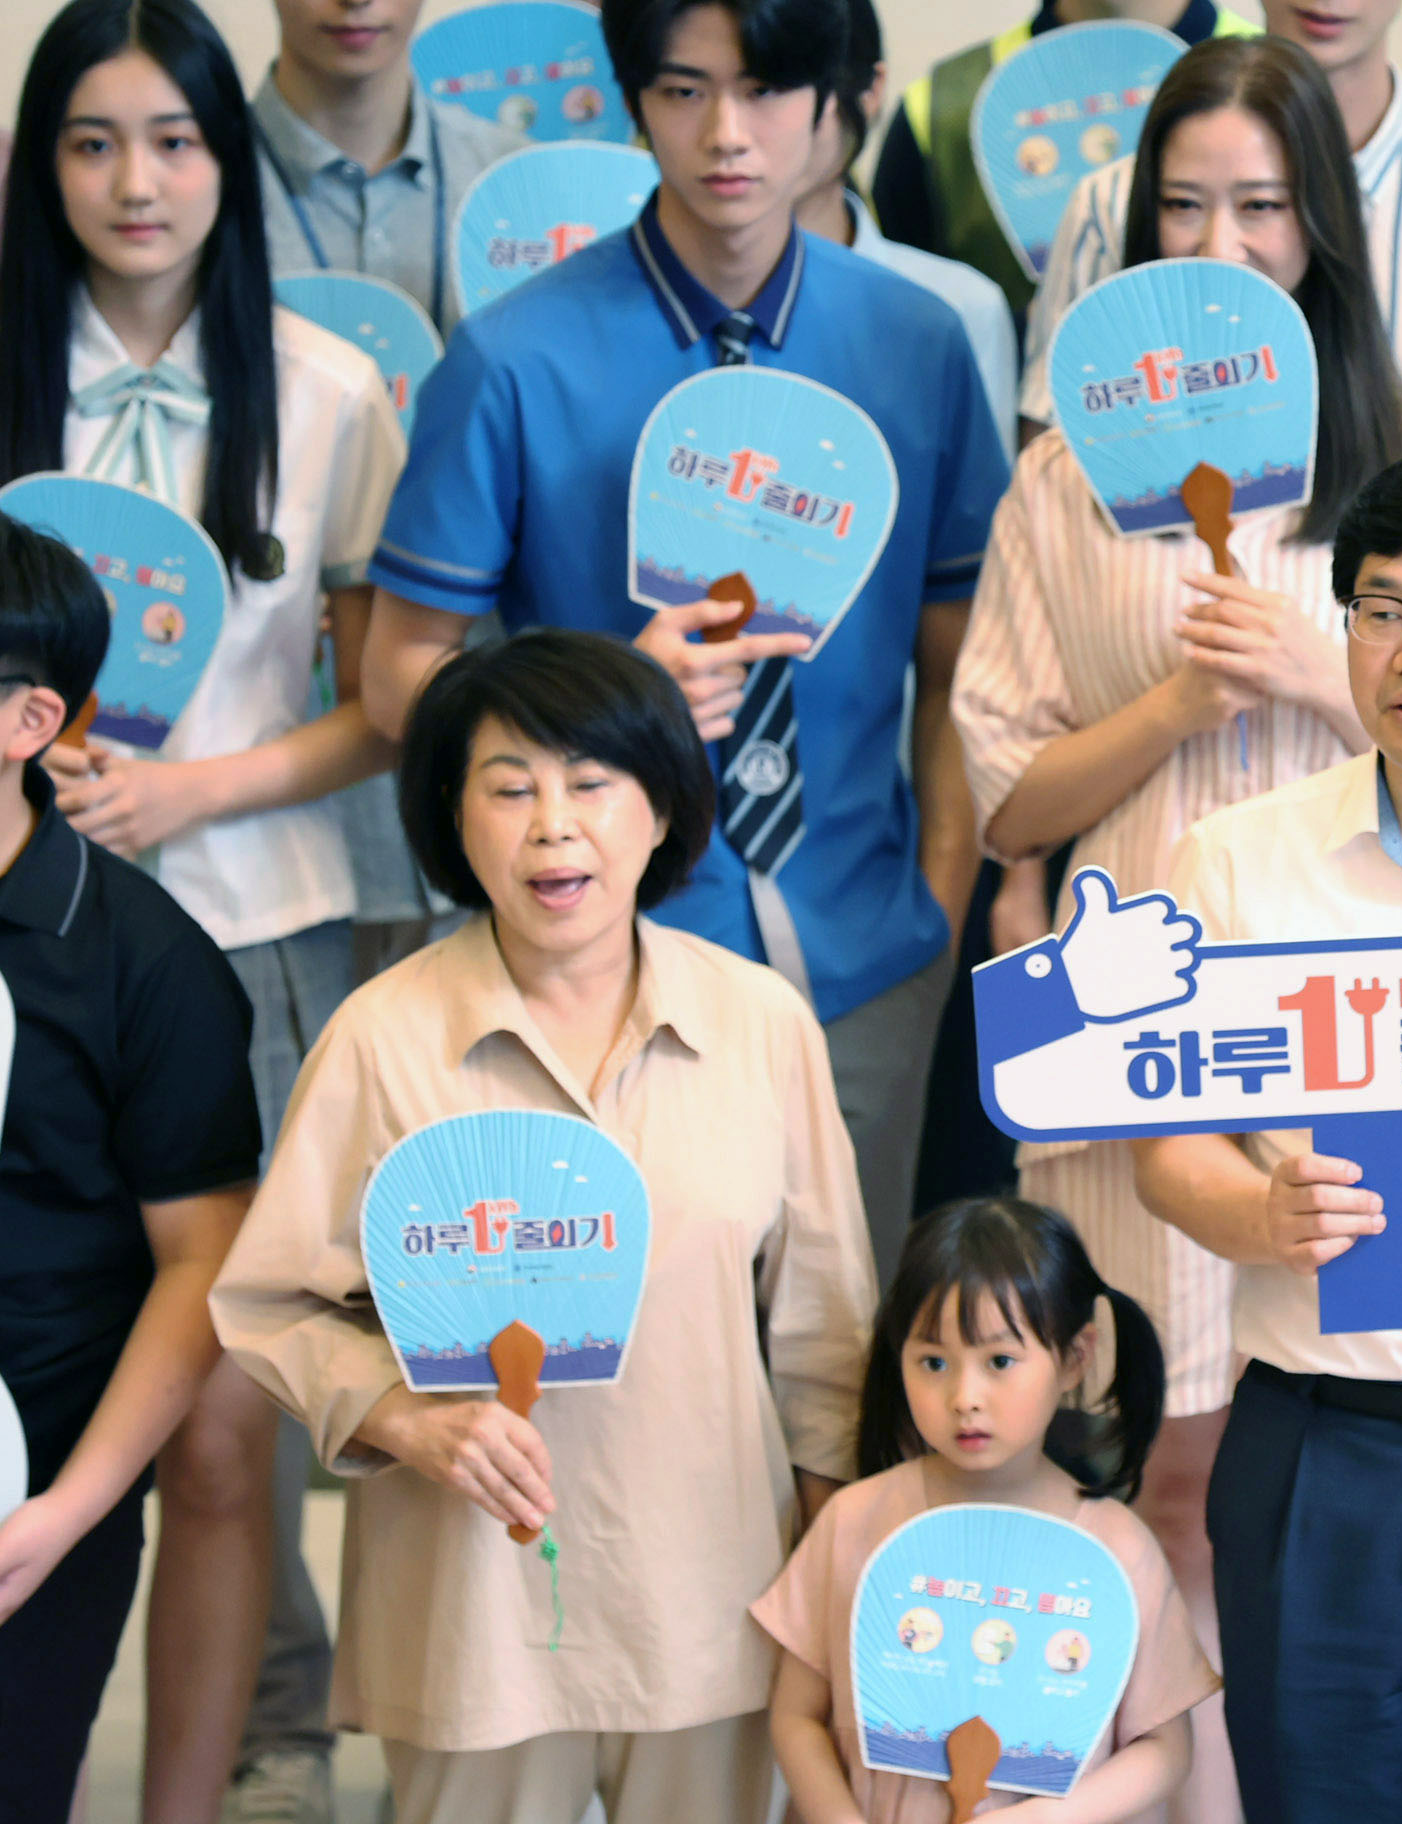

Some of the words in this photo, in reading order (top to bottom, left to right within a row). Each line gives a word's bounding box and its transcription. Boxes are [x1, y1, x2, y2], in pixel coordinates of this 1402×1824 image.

[1082, 375, 1143, 413] 하루
[668, 446, 728, 486] 하루
[1123, 1026, 1292, 1100] 하루
[403, 1223, 470, 1255] 하루
[513, 1213, 618, 1252] 줄이기
